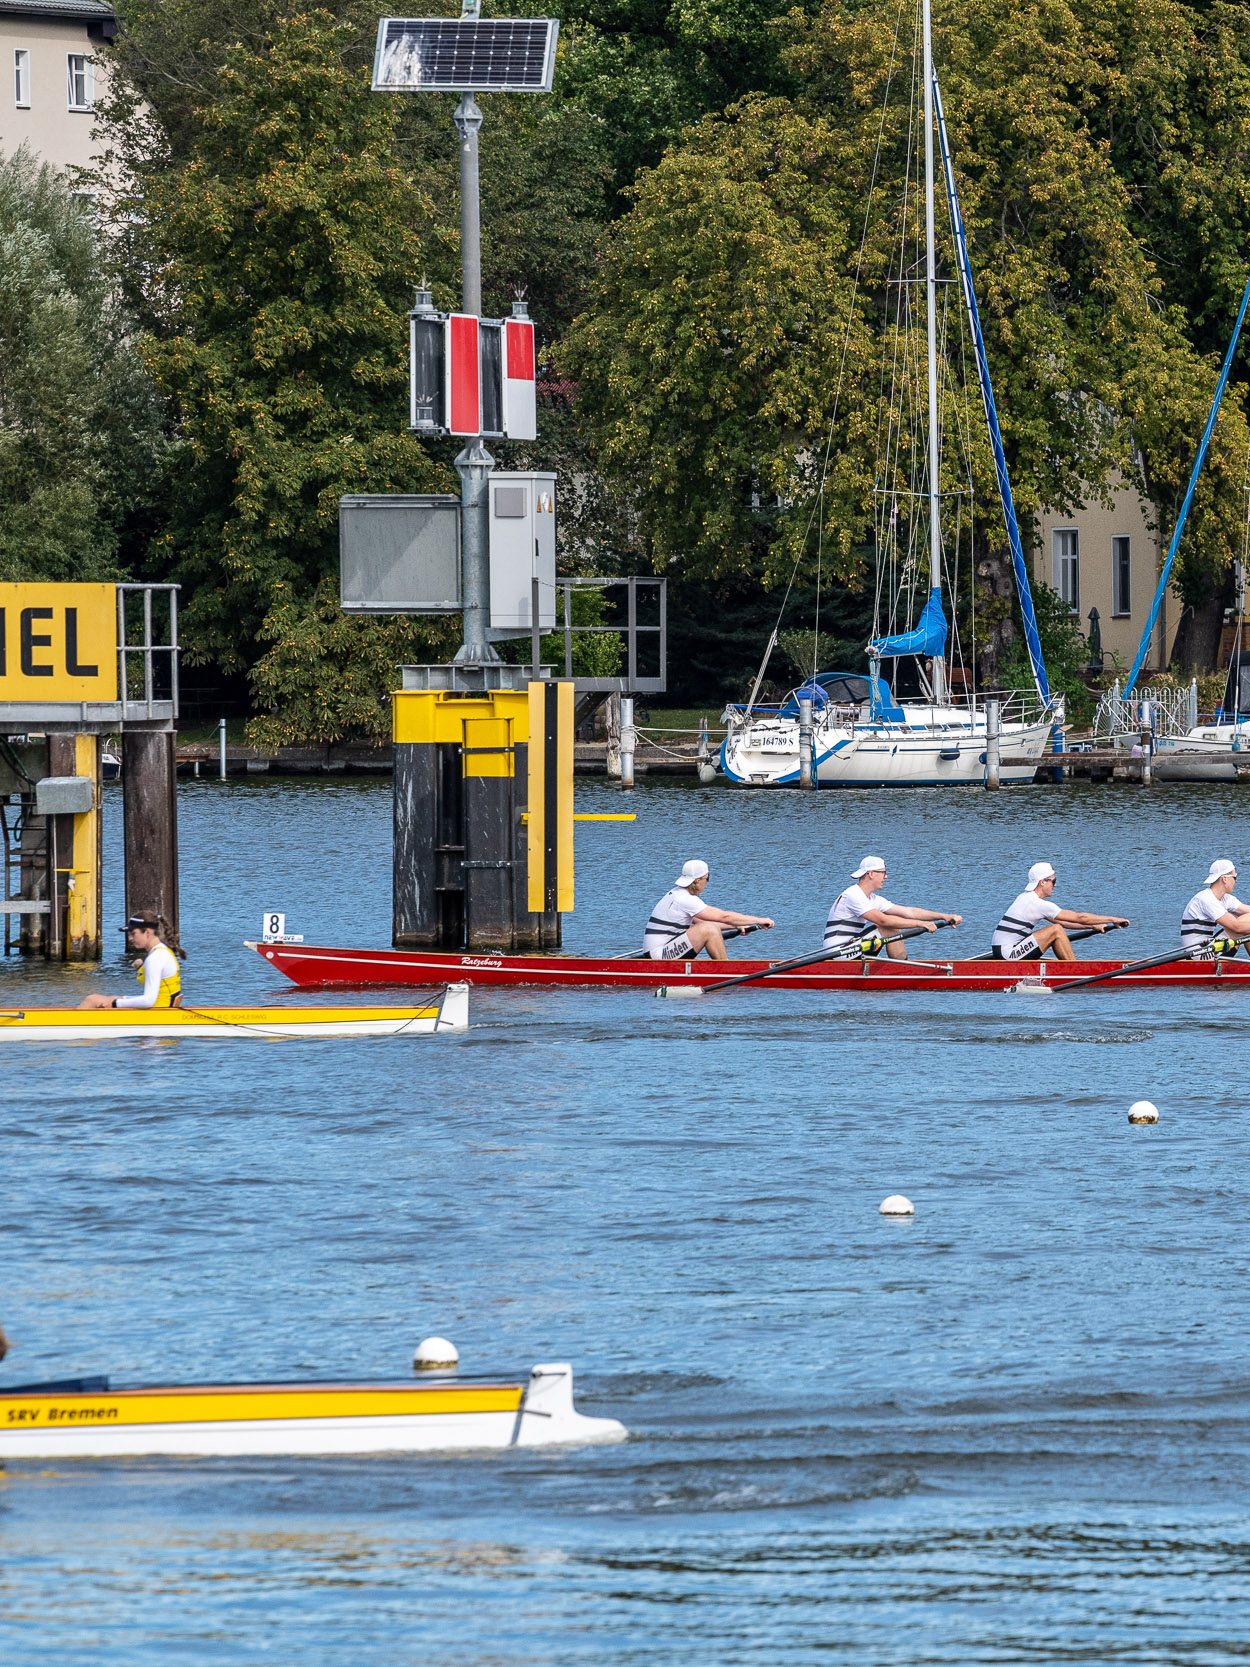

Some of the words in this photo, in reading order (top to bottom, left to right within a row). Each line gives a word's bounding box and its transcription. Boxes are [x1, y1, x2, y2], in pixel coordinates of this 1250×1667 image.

[270, 914, 280, 934] 8
[662, 941, 689, 959] Minden
[1009, 940, 1035, 959] Mnden
[461, 956, 502, 968] Ratzeburg
[48, 1407, 119, 1421] Bremen
